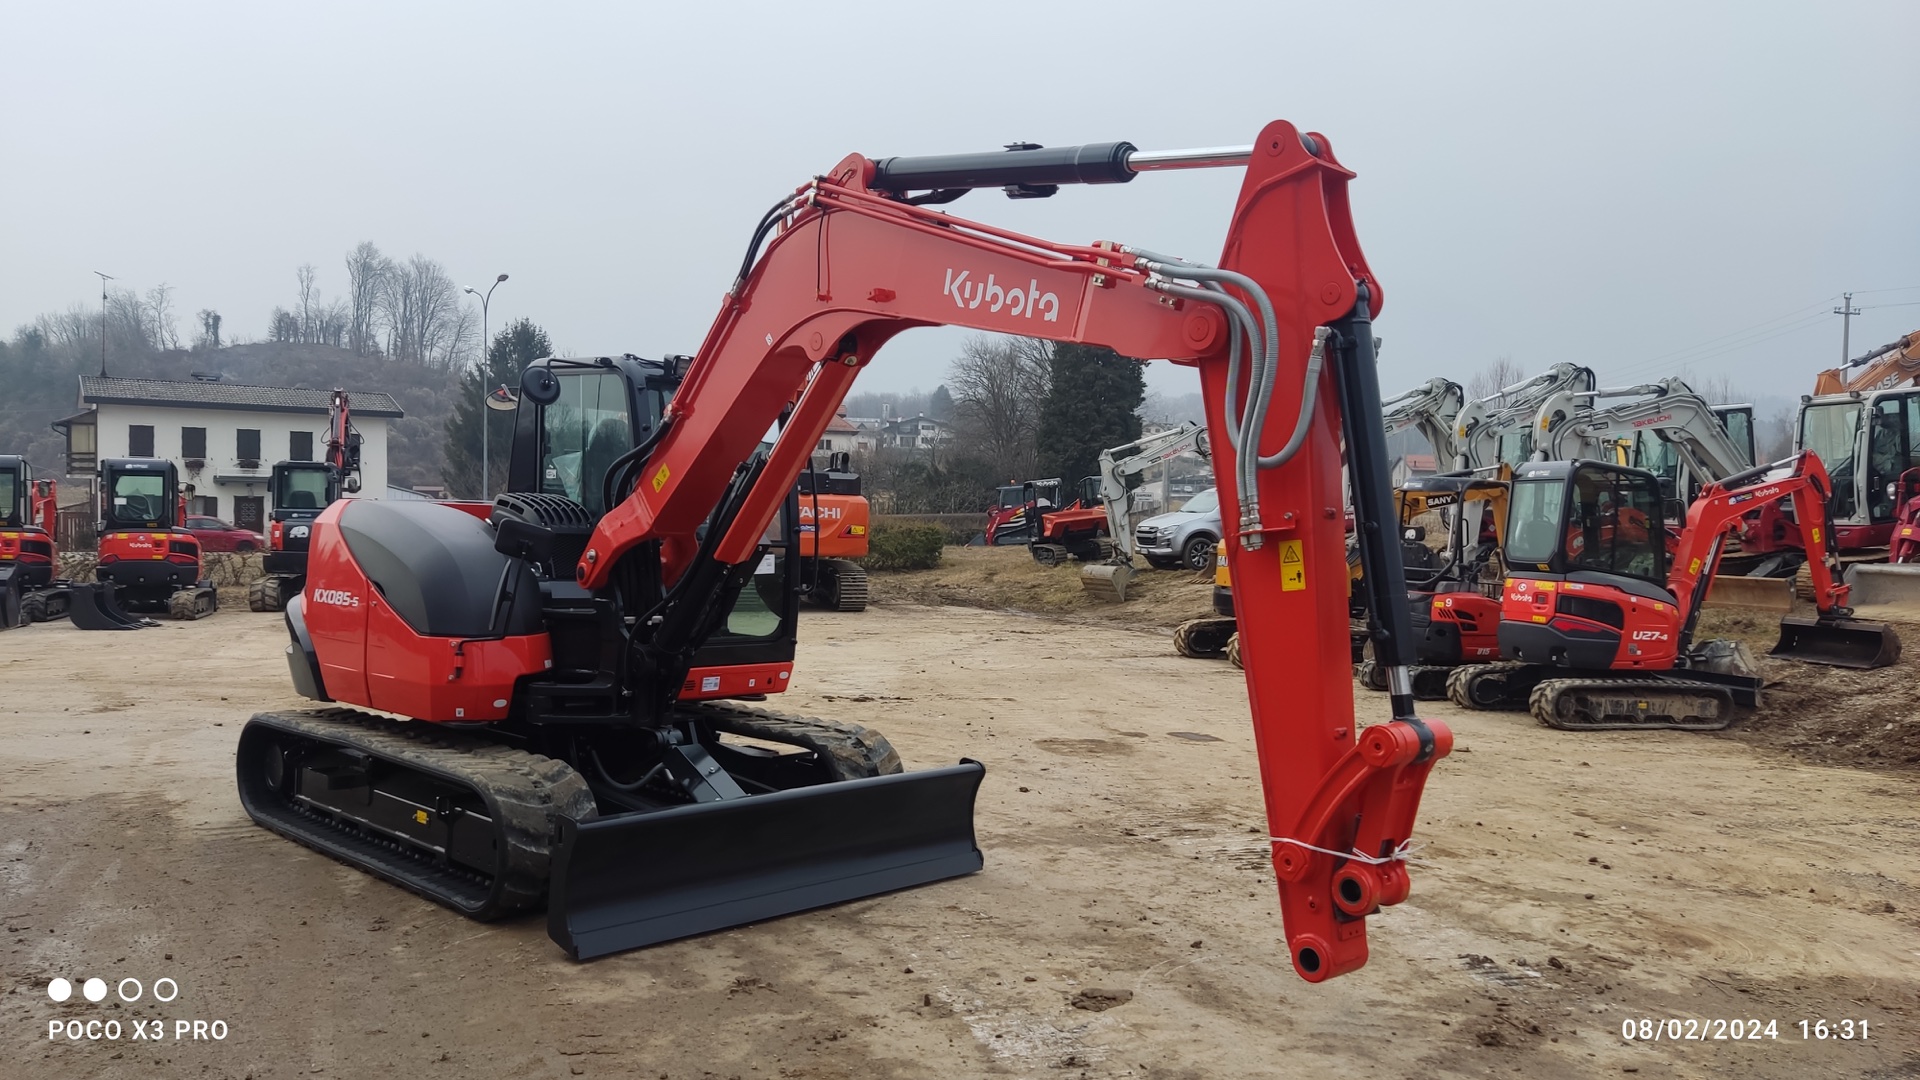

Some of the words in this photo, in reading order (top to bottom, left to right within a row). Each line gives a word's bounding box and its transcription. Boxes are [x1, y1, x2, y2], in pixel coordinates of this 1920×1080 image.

[943, 268, 1059, 322] Kubota
[1632, 414, 1672, 428] TAKEUCHI
[1755, 487, 1780, 498] Kubota
[1427, 495, 1453, 507] SANY
[313, 588, 360, 607] KX085-5
[1445, 598, 1453, 607] 9
[1510, 592, 1533, 603] Kubota
[1632, 630, 1669, 641] U27-4
